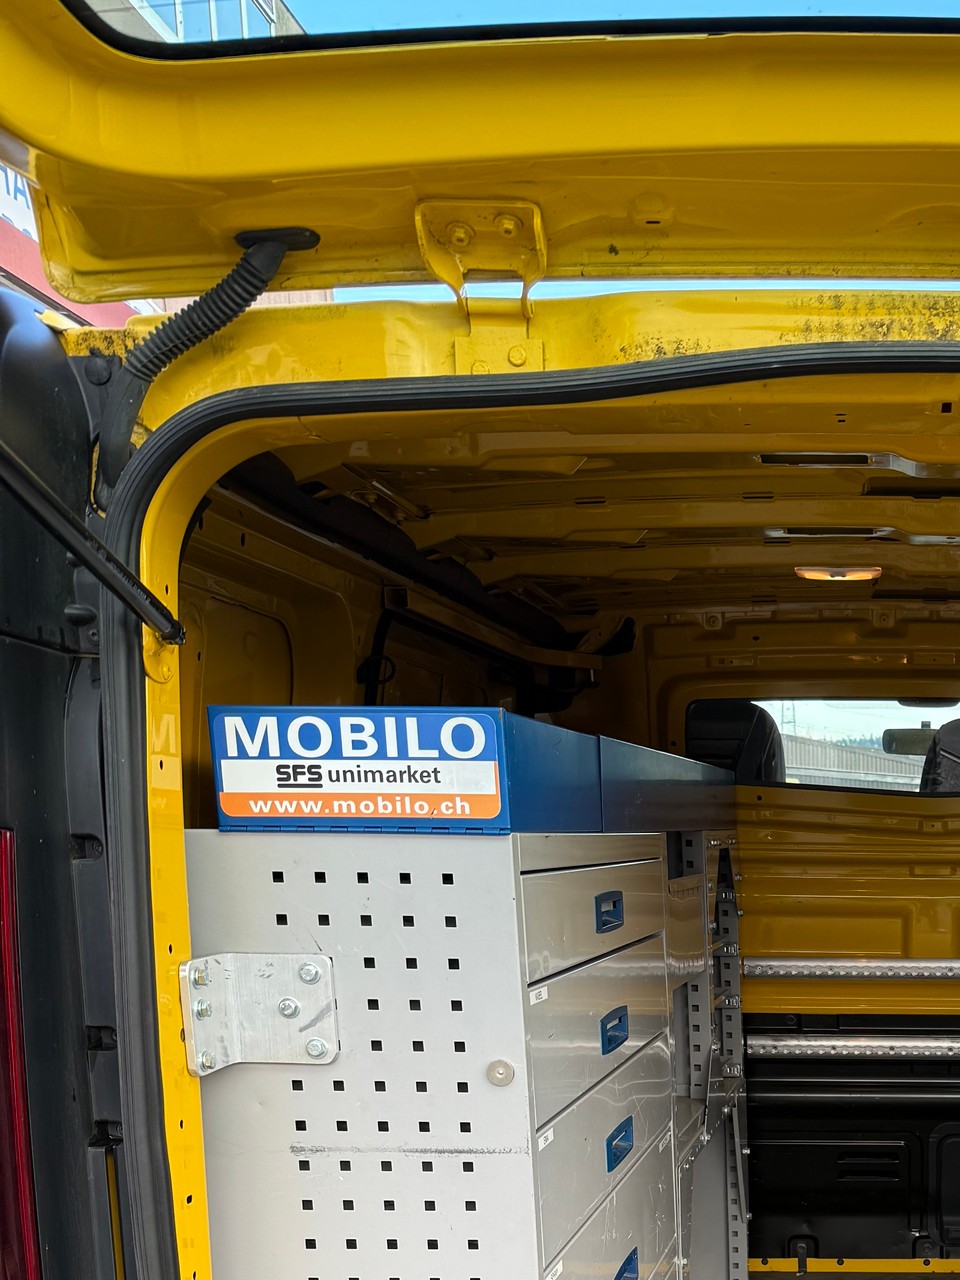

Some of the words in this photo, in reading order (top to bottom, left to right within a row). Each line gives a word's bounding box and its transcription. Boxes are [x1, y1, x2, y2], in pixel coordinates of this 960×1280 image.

[223, 716, 486, 759] MOBILO
[276, 764, 322, 782] SFS
[328, 765, 441, 783] unimarket
[249, 797, 470, 815] www.mobilo.ch
